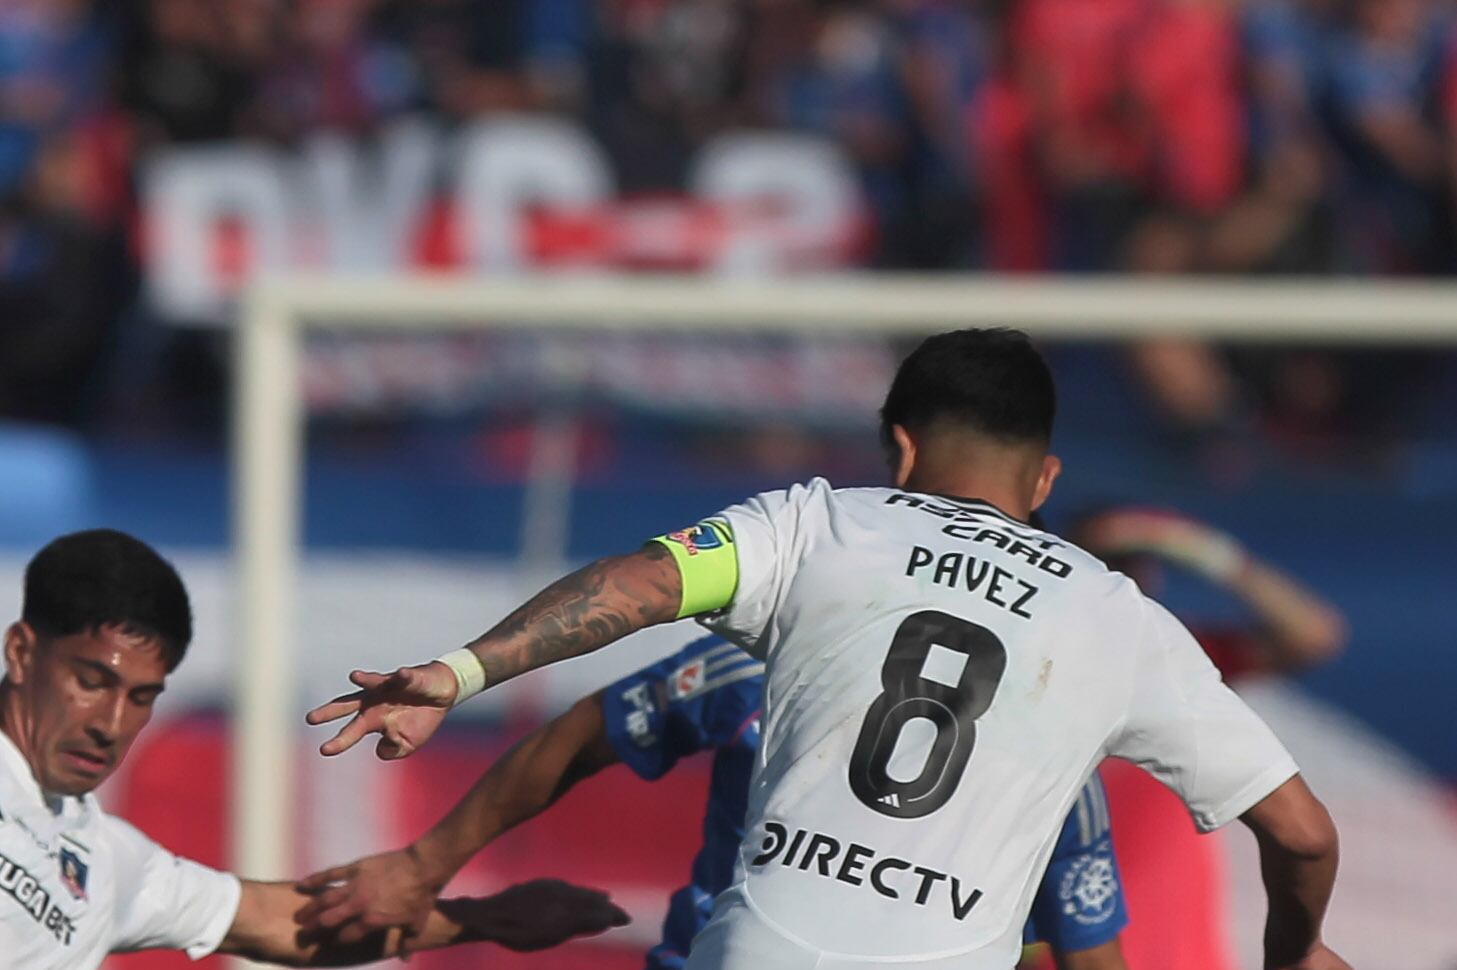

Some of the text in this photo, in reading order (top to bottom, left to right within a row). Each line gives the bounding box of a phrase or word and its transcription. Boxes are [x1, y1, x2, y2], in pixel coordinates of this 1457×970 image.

[905, 546, 1039, 619] PAVEZ
[942, 525, 1073, 578] CARD
[848, 610, 1007, 819] 8
[751, 822, 984, 921] DIRECTV
